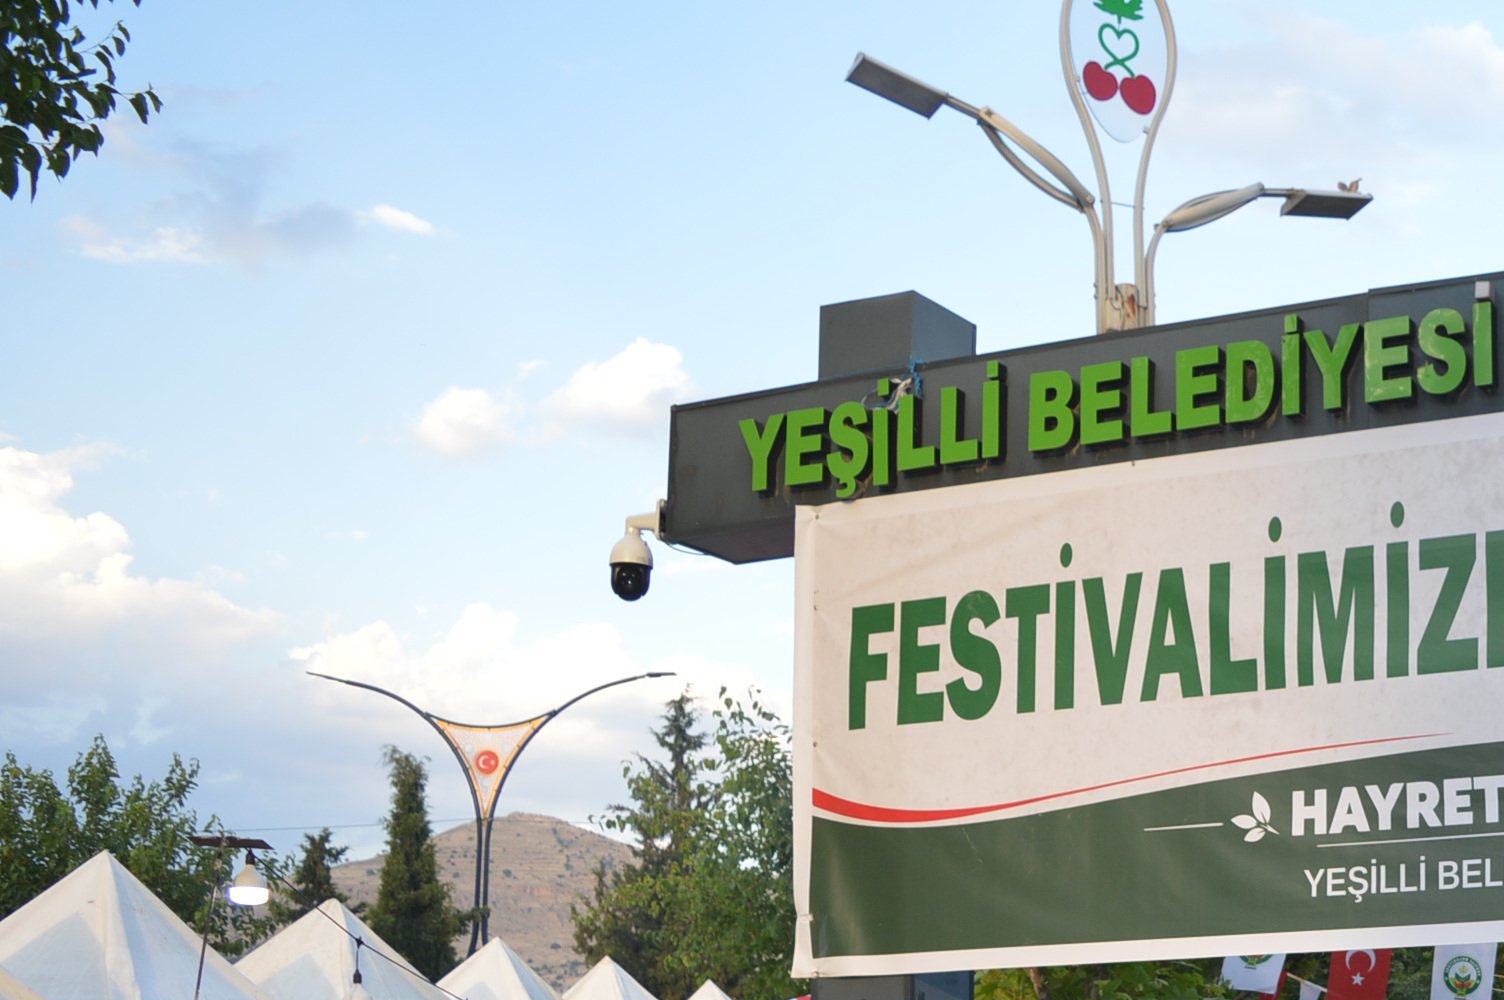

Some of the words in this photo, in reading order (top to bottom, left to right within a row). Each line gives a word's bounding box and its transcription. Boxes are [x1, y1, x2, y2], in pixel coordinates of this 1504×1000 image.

[738, 360, 1004, 500] YEŞİLLİ
[1026, 280, 1494, 454] BELEDİYESİ
[1303, 855, 1427, 903] YEŞİLLİ
